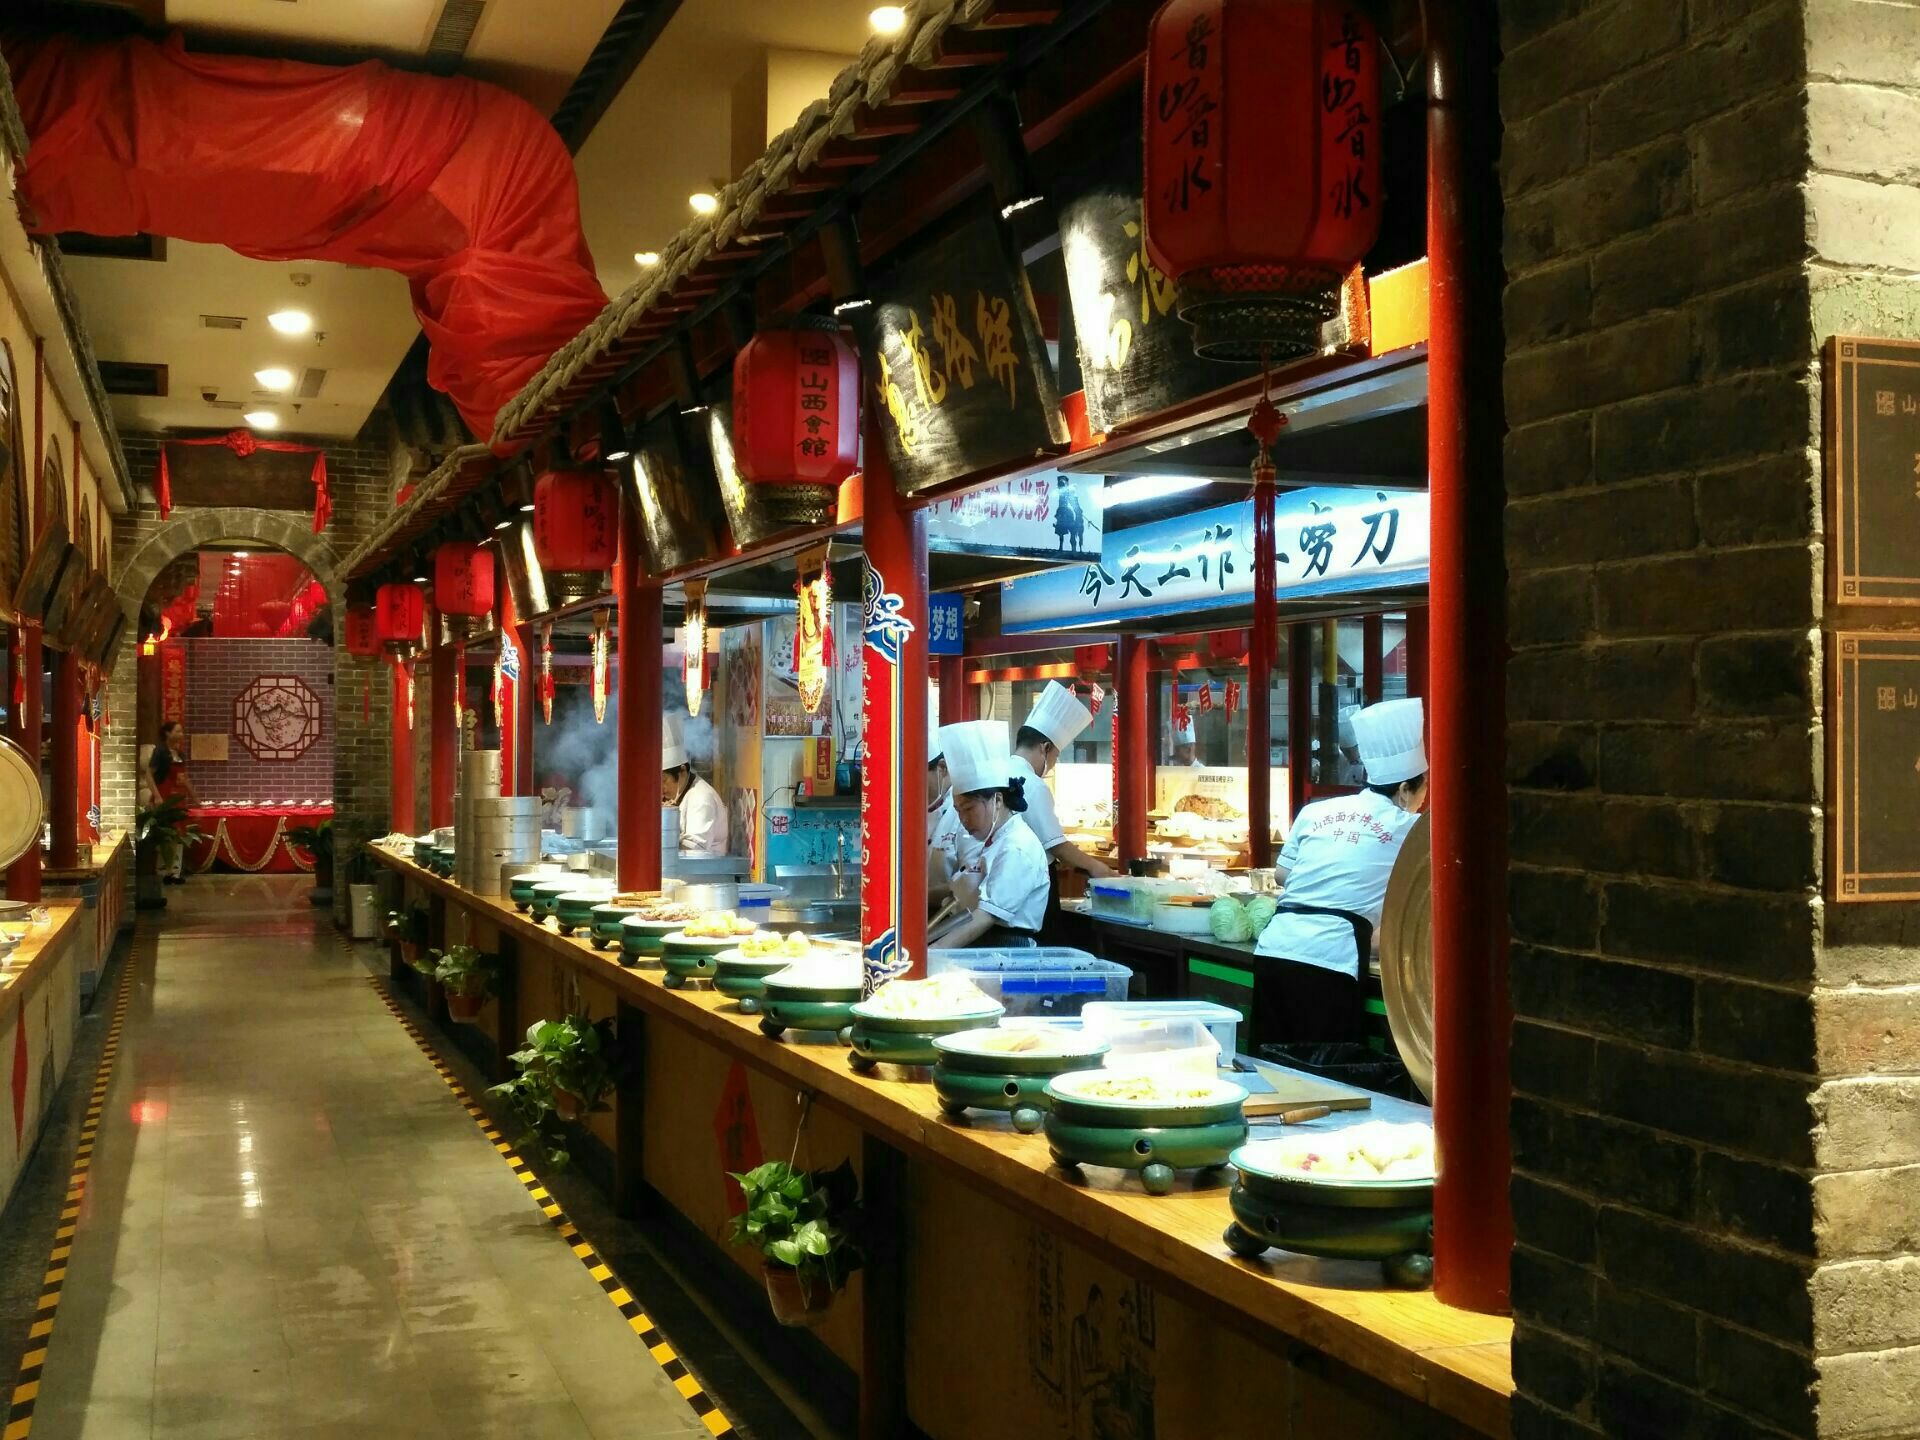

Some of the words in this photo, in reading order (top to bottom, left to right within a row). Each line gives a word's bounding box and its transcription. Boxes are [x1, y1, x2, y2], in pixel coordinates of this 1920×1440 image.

[1079, 491, 1400, 608] 今天工作努力
[928, 605, 958, 641] 梦想
[1333, 827, 1361, 845] 中国
